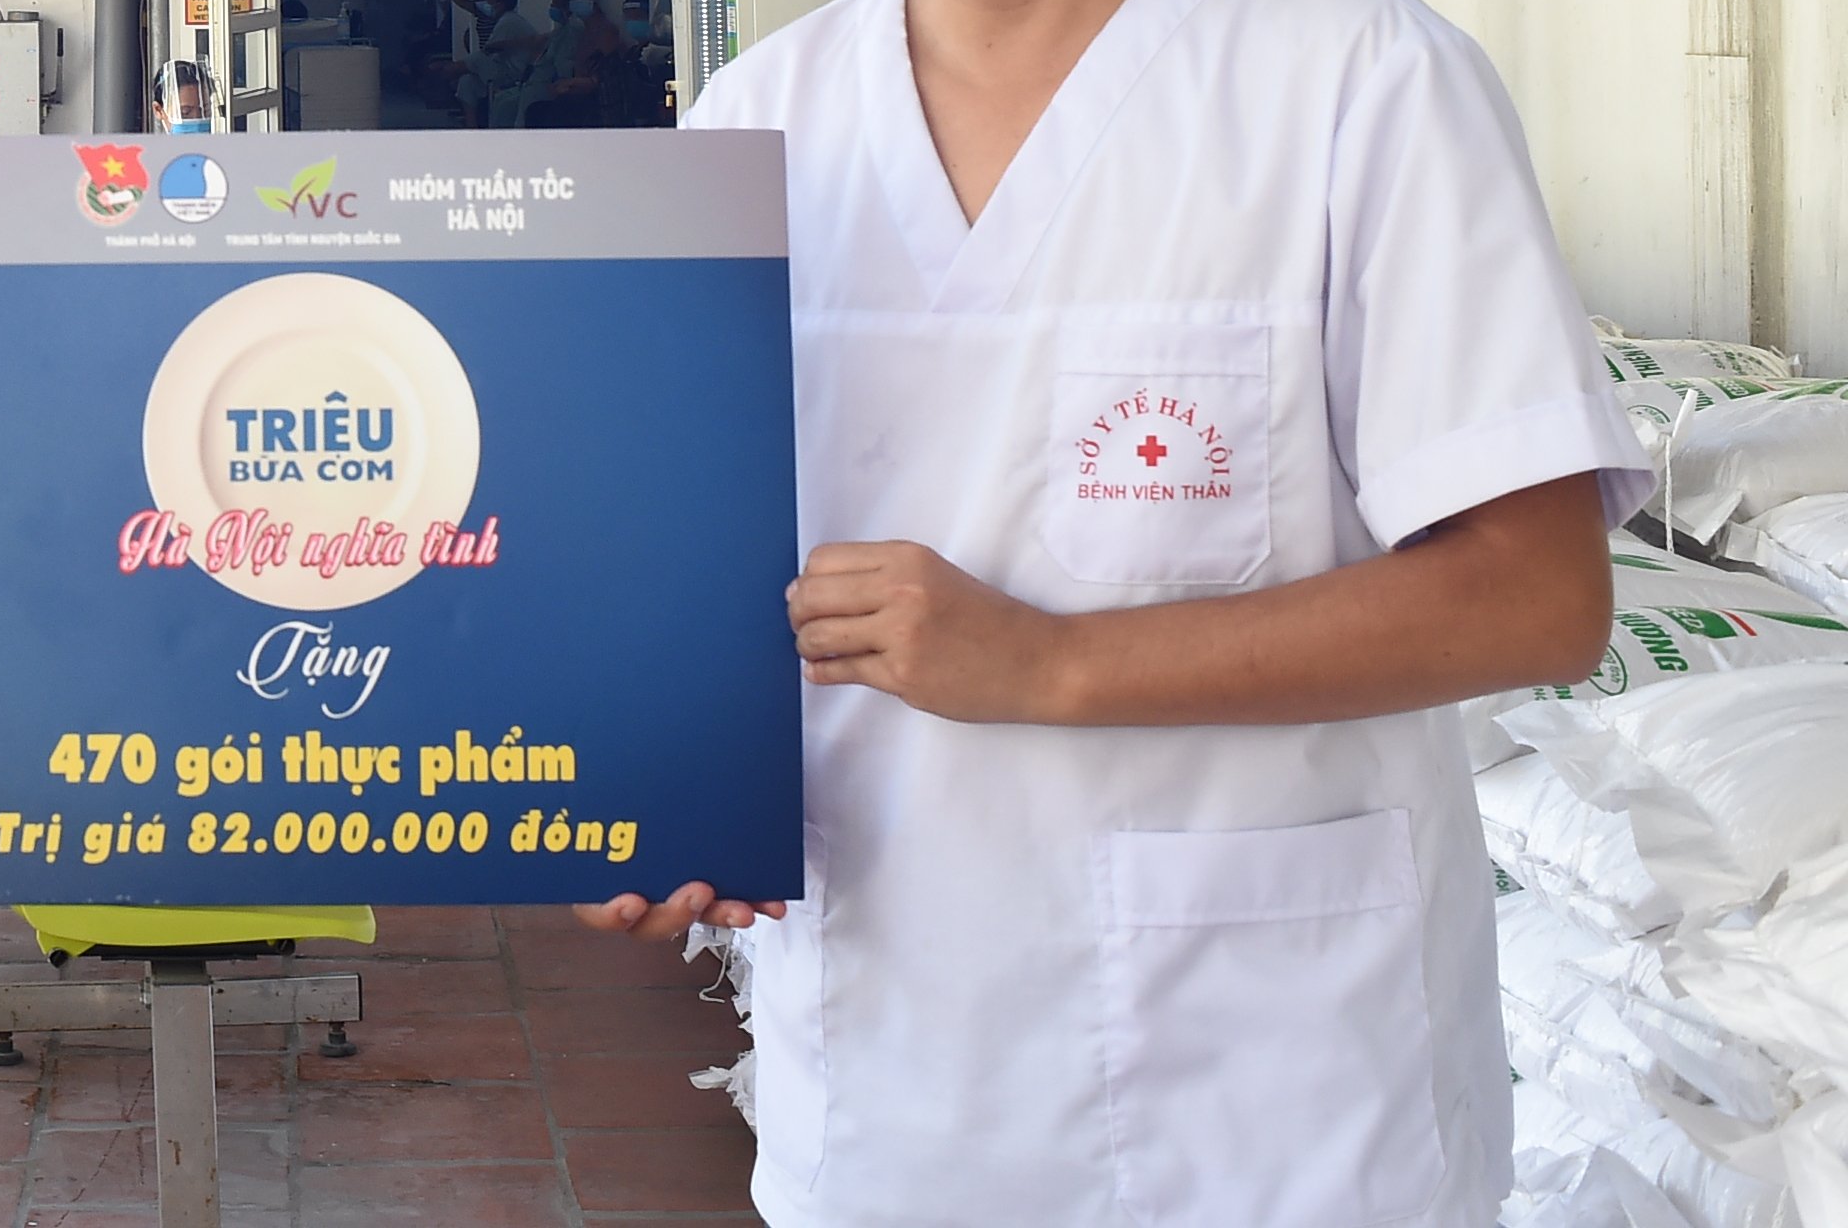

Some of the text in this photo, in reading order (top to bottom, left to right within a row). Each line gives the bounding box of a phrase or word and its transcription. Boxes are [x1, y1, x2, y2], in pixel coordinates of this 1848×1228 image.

[389, 173, 455, 201] NHÓM
[447, 202, 525, 237] HÀ NỘI
[226, 390, 394, 459] TRIỆU
[1092, 415, 1113, 435] Y
[1113, 387, 1150, 420] TẾ
[229, 454, 394, 483] BỮA CƠM
[1078, 479, 1126, 504] BỆNH
[1132, 480, 1174, 505] VIỆN
[117, 507, 500, 580] Hà Nội nghĩa tình
[236, 620, 392, 720] Tặng
[48, 725, 576, 797] 470 gói thực phẩm
[83, 811, 166, 864] giá
[188, 811, 489, 855] 82.000.000
[509, 807, 638, 864] đồng
